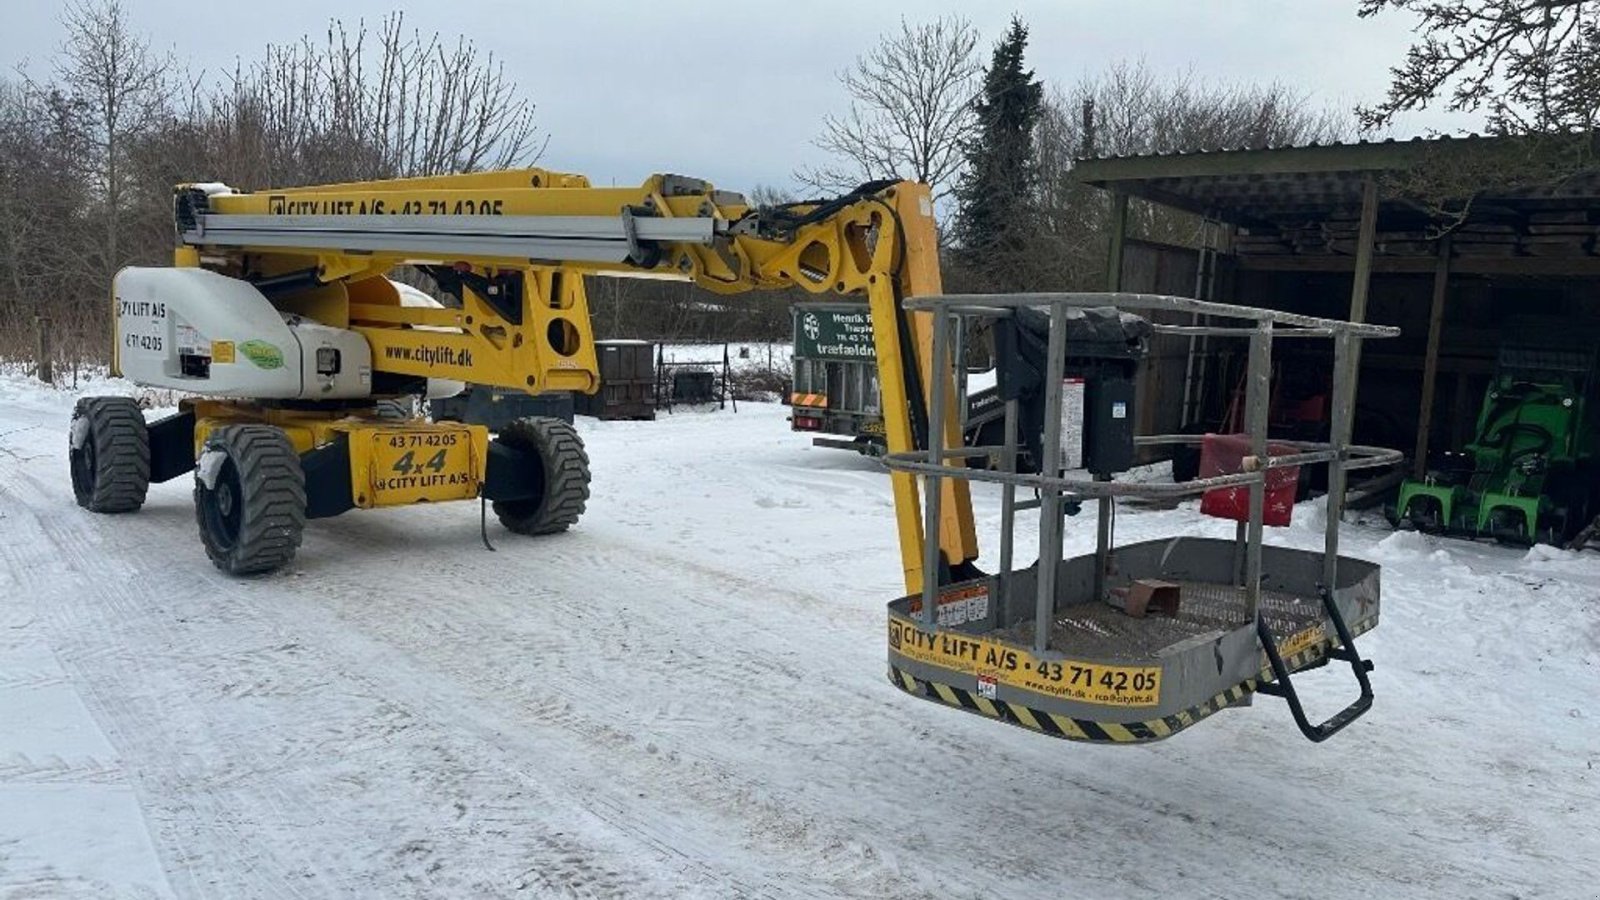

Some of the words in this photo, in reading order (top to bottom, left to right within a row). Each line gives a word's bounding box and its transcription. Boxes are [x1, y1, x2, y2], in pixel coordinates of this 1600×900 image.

[833, 313, 864, 323] Henrik
[385, 344, 473, 368] www.citylift.dk
[816, 343, 876, 356] træfældn
[390, 436, 405, 448] 43
[410, 435, 422, 447] 71
[425, 435, 440, 447] 42
[442, 434, 456, 446] 05
[391, 448, 448, 475] 4x4
[388, 476, 417, 490] CITY
[420, 474, 446, 487] LIFT
[449, 473, 469, 485] A/S
[903, 626, 937, 651] CITY
[943, 636, 980, 660] LIFT
[985, 647, 1017, 671] A/S
[1037, 661, 1063, 681] 43
[1070, 665, 1093, 687] 71
[1100, 671, 1128, 691] 42
[1133, 671, 1156, 691] 05
